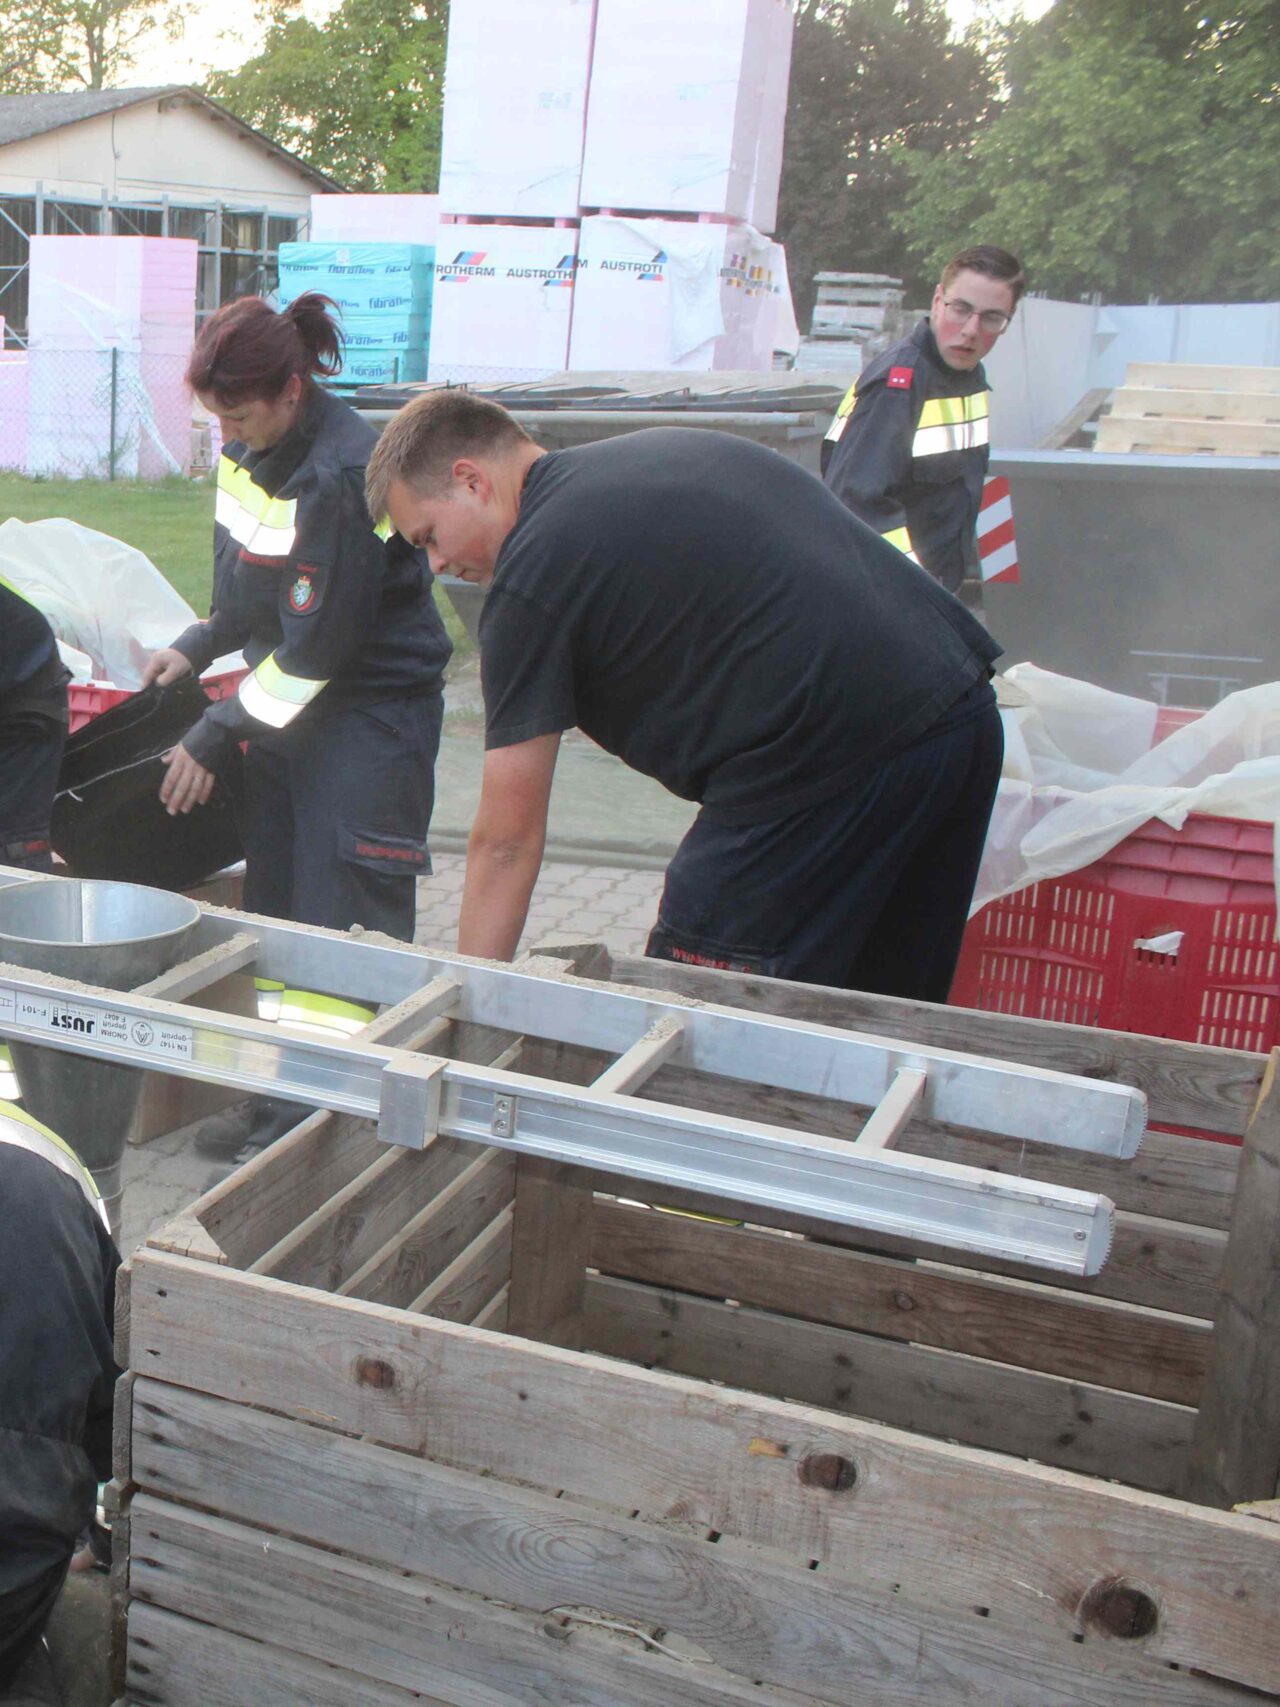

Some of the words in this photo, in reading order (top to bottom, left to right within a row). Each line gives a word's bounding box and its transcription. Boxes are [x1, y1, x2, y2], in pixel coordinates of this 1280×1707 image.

[23, 1005, 46, 1016] F-101
[50, 1012, 95, 1034] JUST
[160, 1040, 175, 1049] 1147
[177, 1044, 188, 1052] EN
